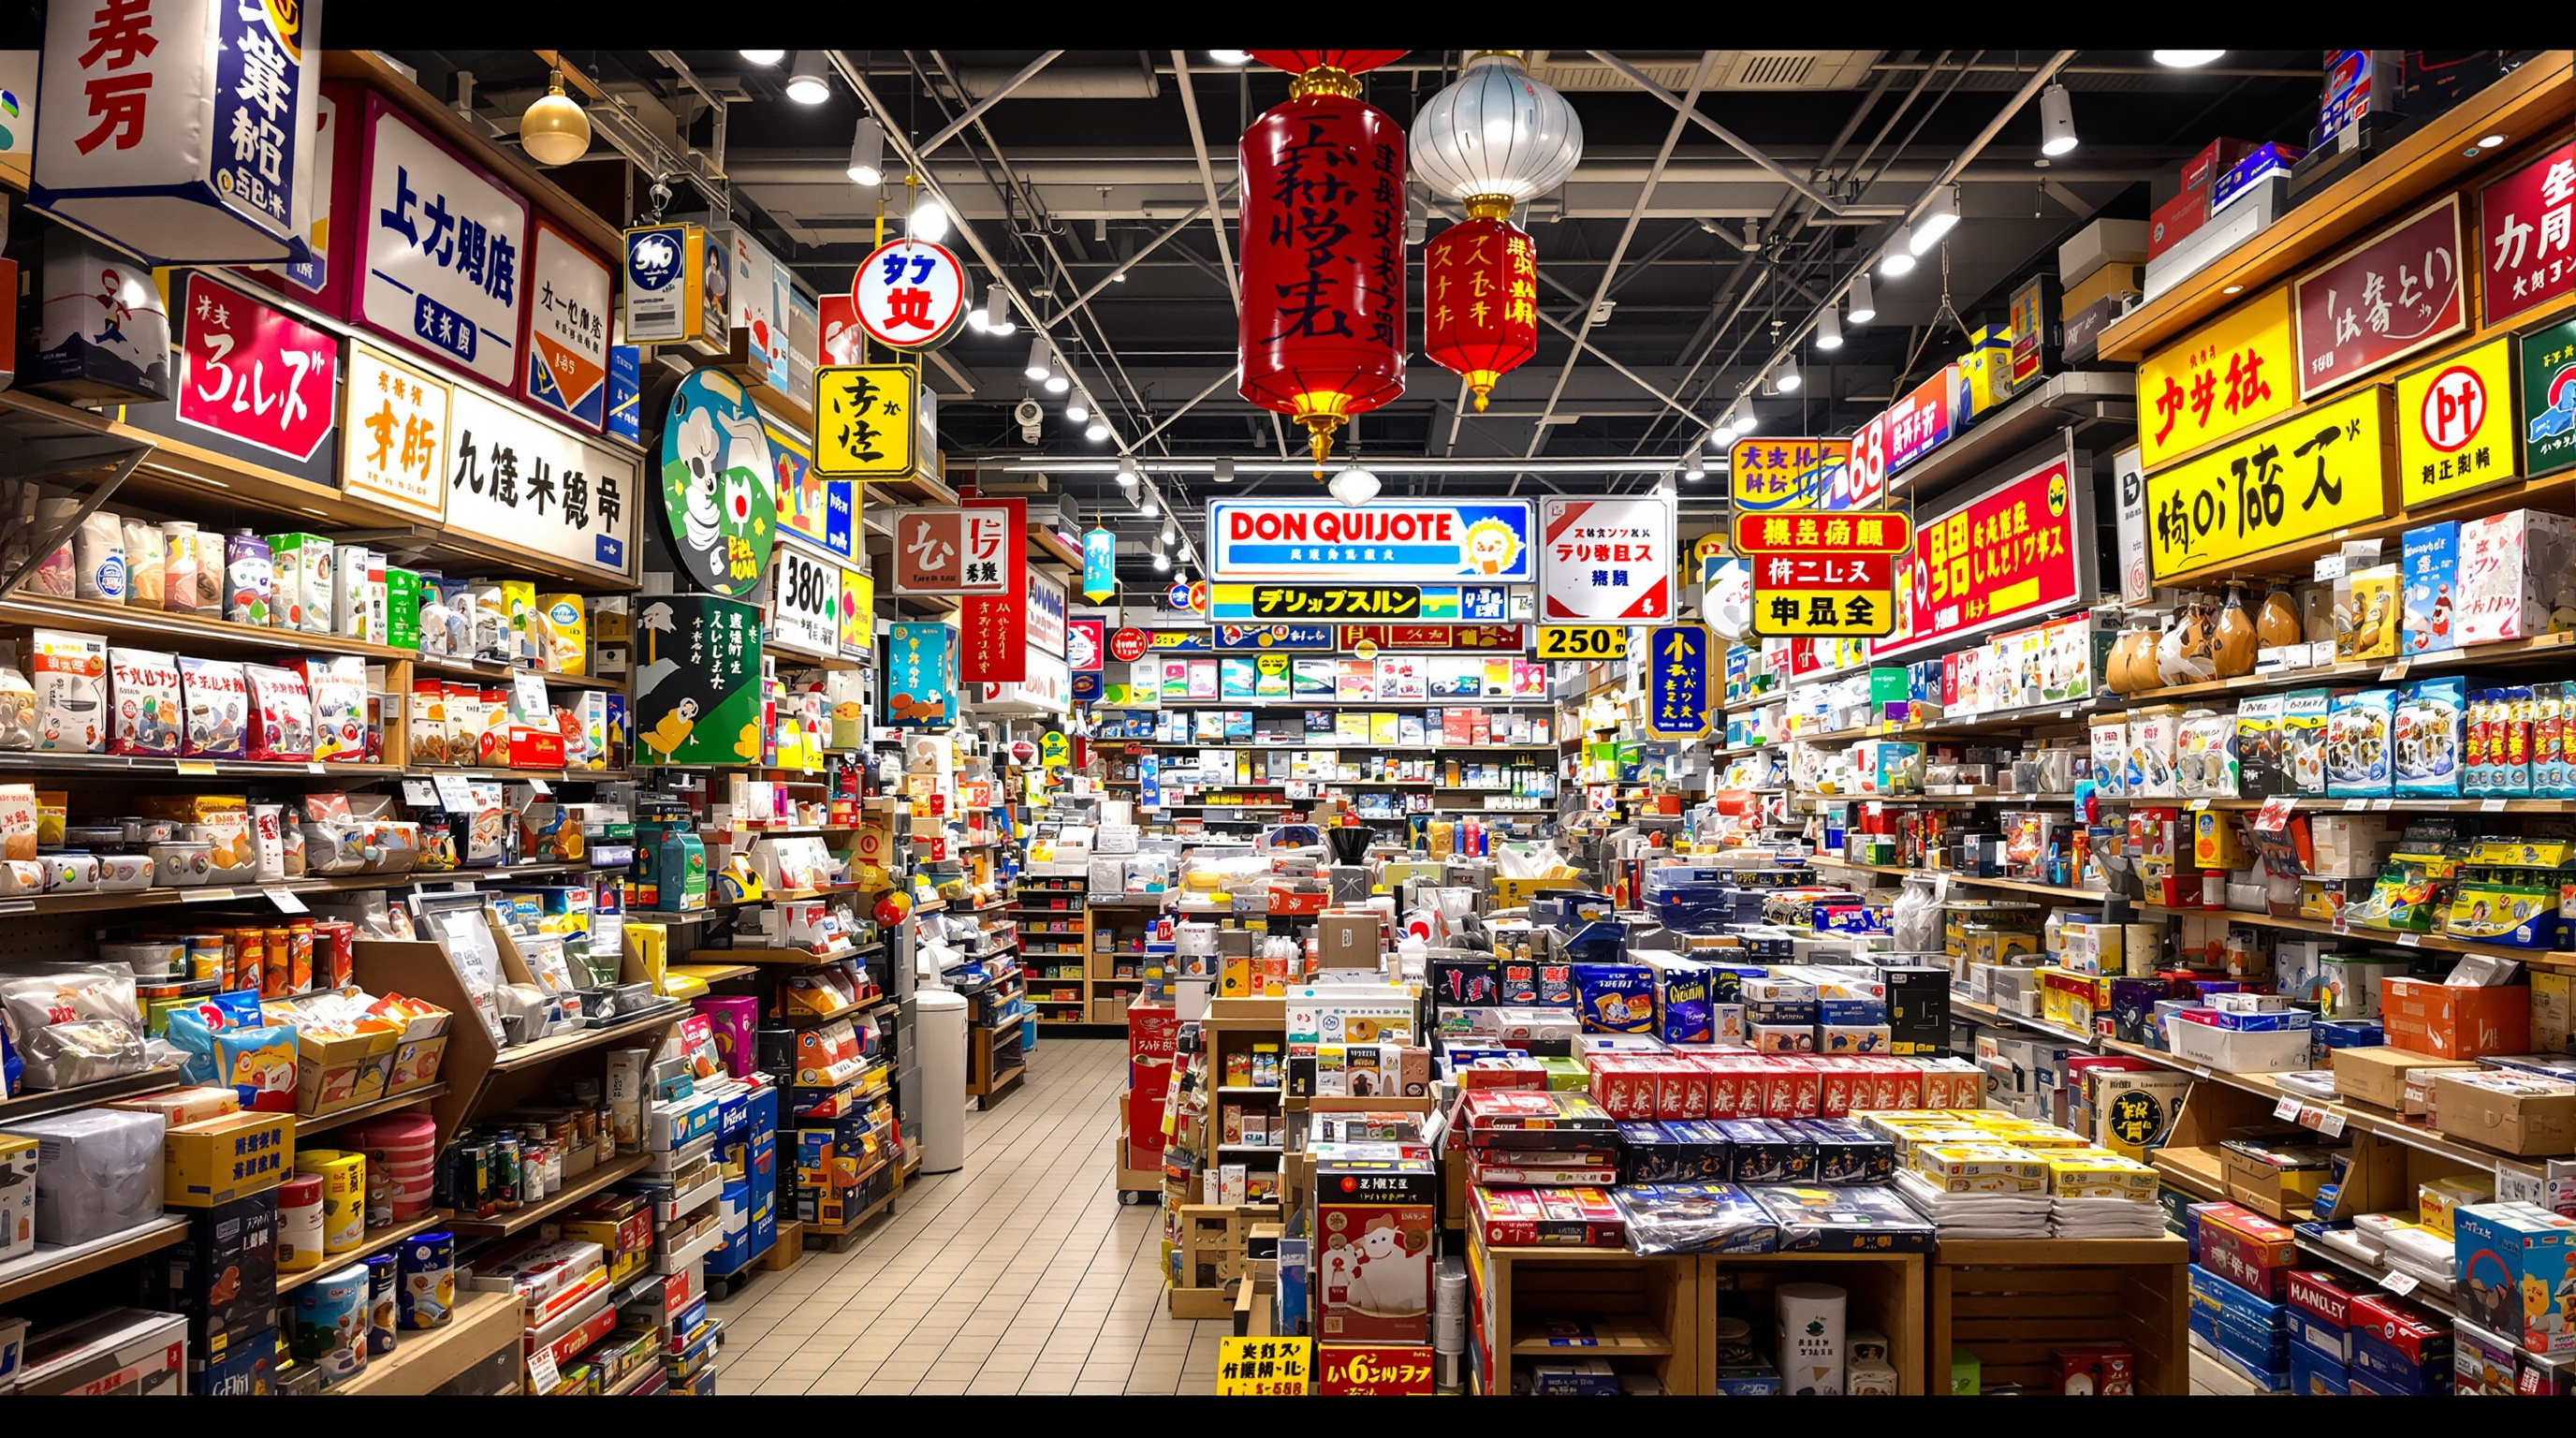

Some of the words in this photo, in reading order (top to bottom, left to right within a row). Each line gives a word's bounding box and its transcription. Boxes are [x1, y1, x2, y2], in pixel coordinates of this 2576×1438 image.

[1230, 512, 1307, 540] DON
[1313, 512, 1452, 543] QUIJOTE
[785, 555, 824, 615] 380
[1547, 629, 1610, 653] 250
